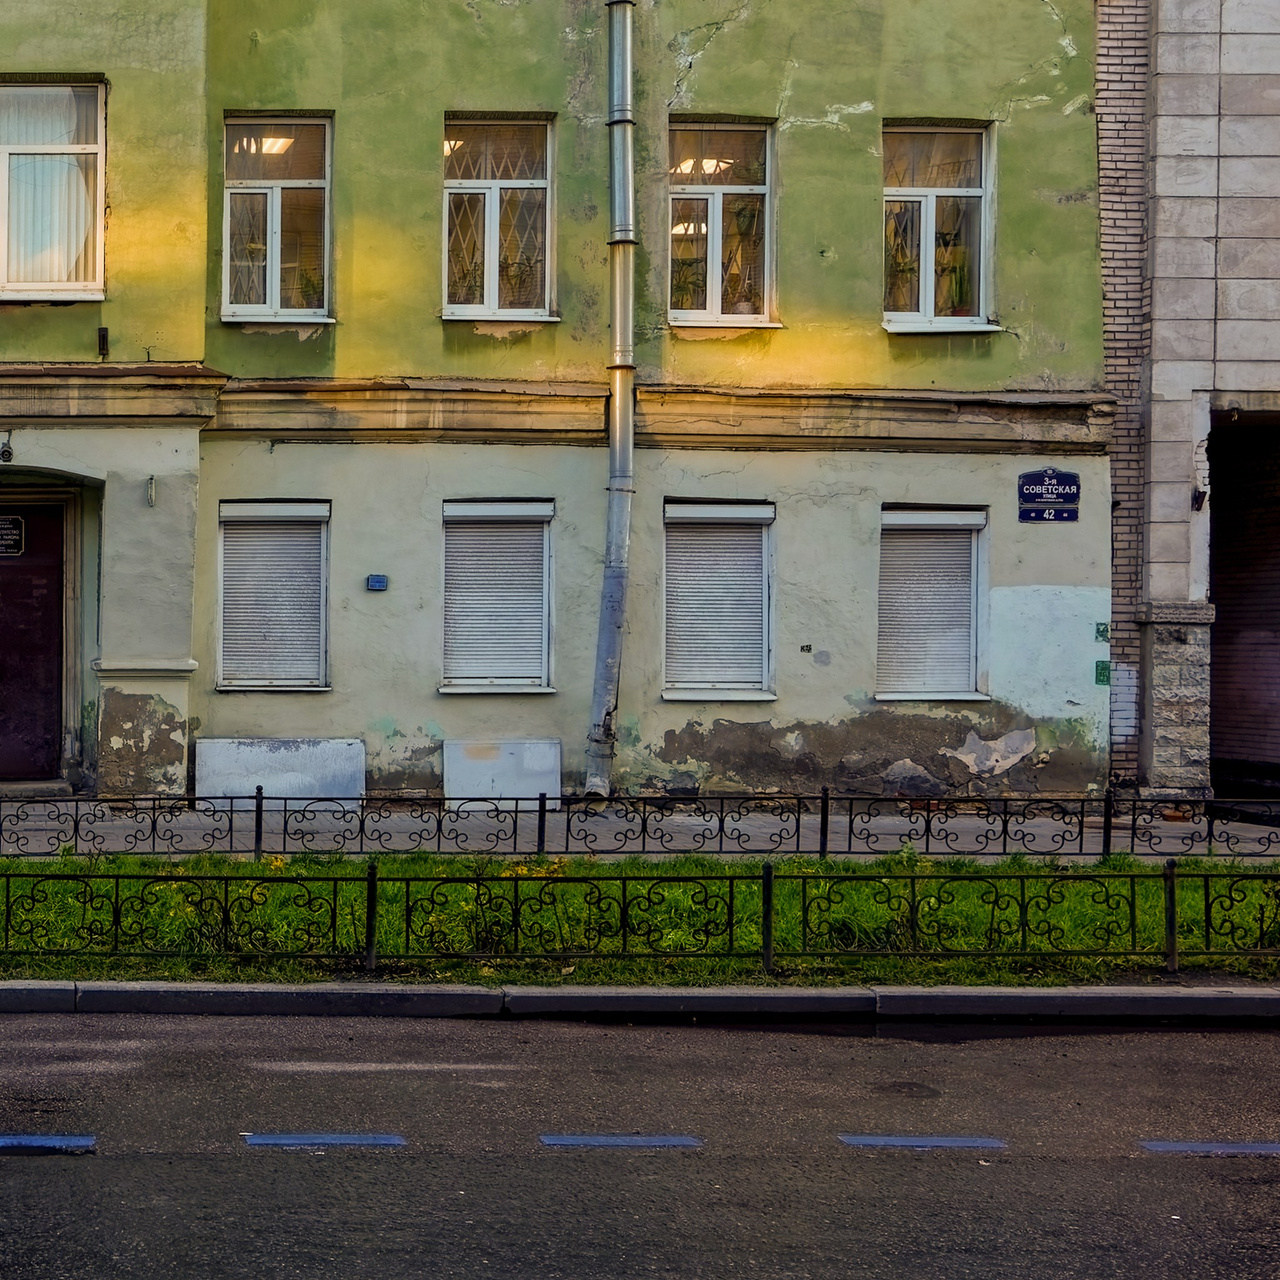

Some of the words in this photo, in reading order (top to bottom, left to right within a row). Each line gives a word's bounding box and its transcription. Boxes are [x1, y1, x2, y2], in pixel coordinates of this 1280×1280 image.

[1044, 477, 1057, 485] 3-я
[1023, 485, 1077, 493] СОВЕТСКАЯ
[1043, 509, 1055, 519] 42
